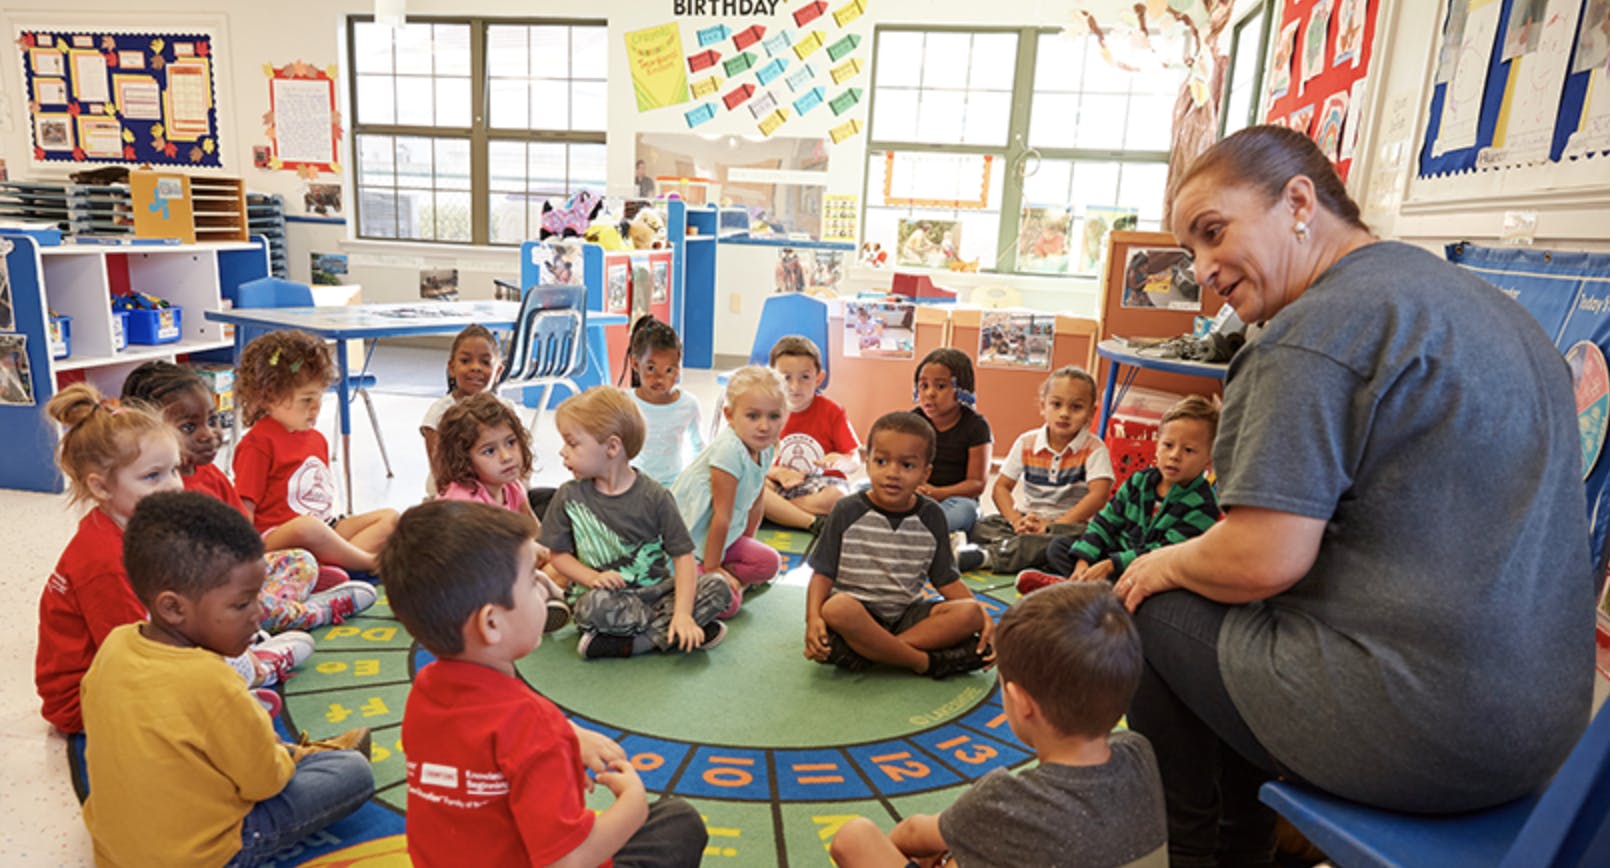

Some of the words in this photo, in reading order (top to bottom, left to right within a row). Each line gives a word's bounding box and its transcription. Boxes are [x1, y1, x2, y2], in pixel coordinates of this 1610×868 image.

[673, 0, 780, 16] BIRTHDAY
[935, 735, 999, 765] 13
[702, 755, 755, 788] 10
[791, 762, 845, 785] 11
[869, 751, 932, 782] 12
